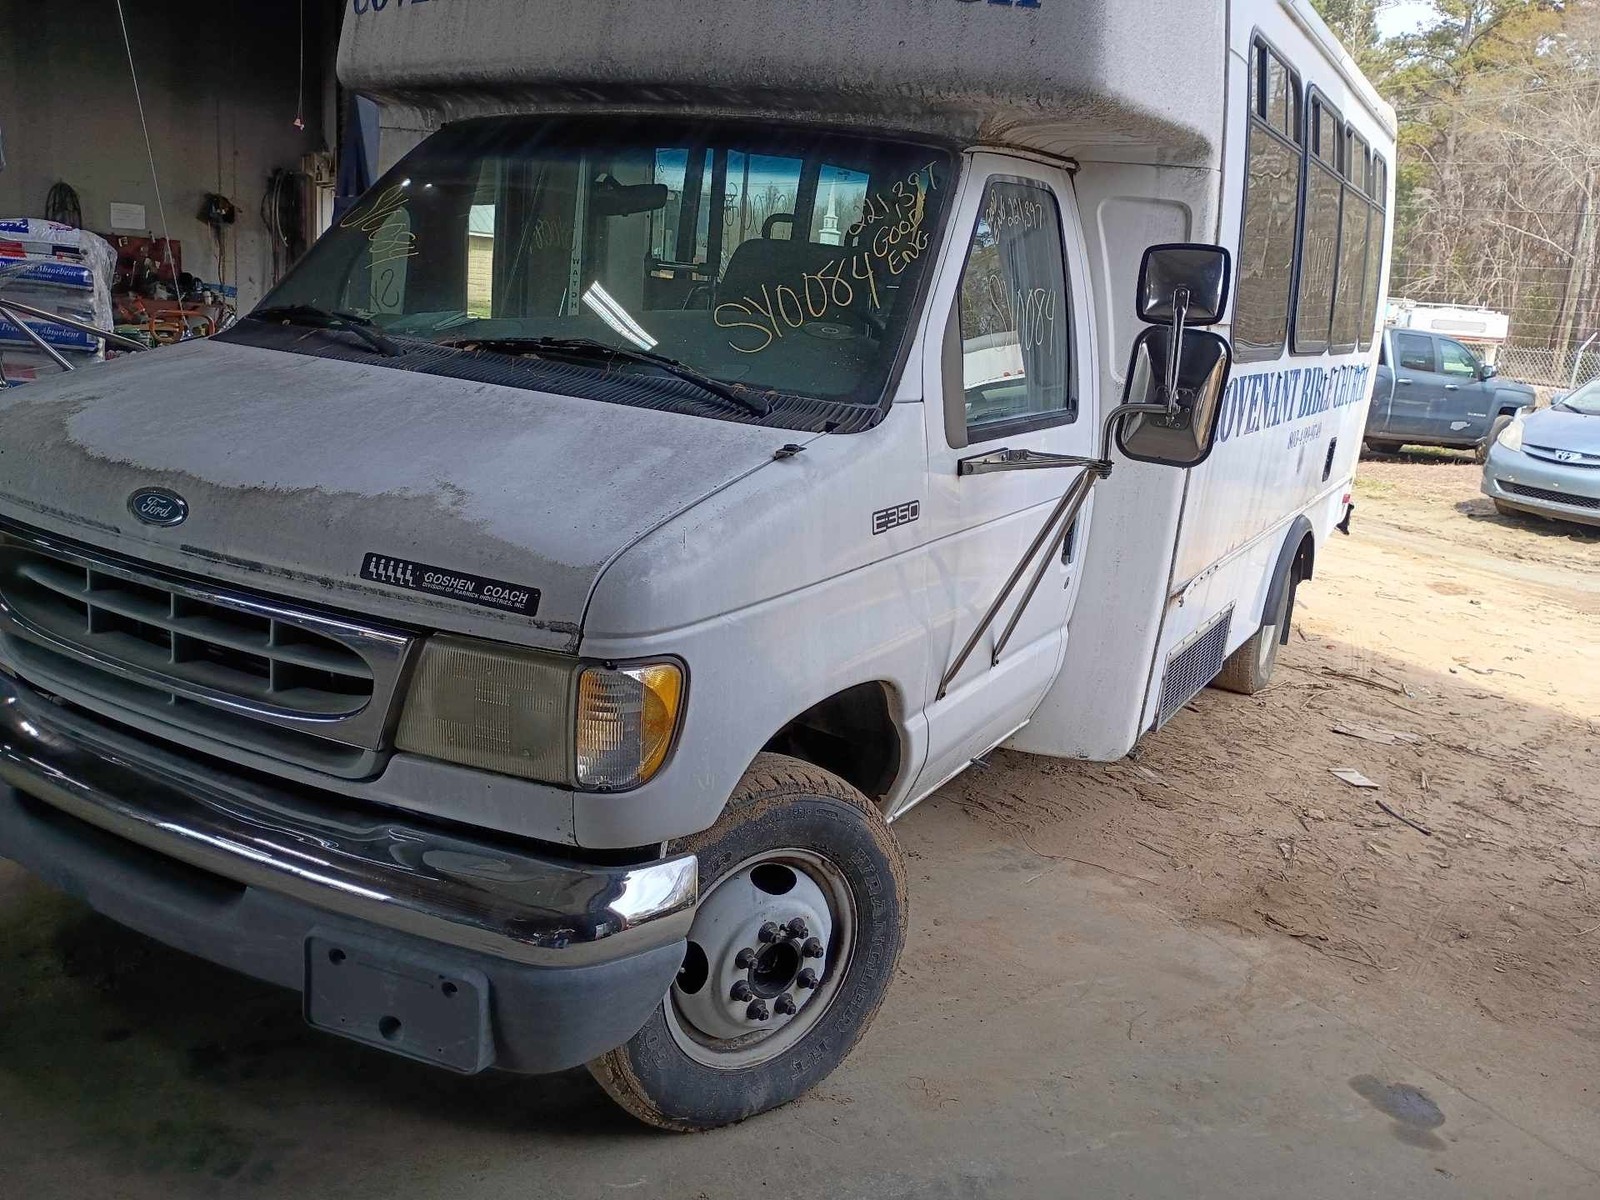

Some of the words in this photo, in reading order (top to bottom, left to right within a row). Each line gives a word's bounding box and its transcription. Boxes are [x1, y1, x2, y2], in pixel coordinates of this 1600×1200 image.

[1213, 367, 1302, 443] OVENANT
[141, 496, 172, 517] Ford
[872, 499, 920, 535] E350
[421, 582, 445, 591] DIVISION
[424, 572, 475, 591] GOSHEN
[483, 585, 529, 603] COACH
